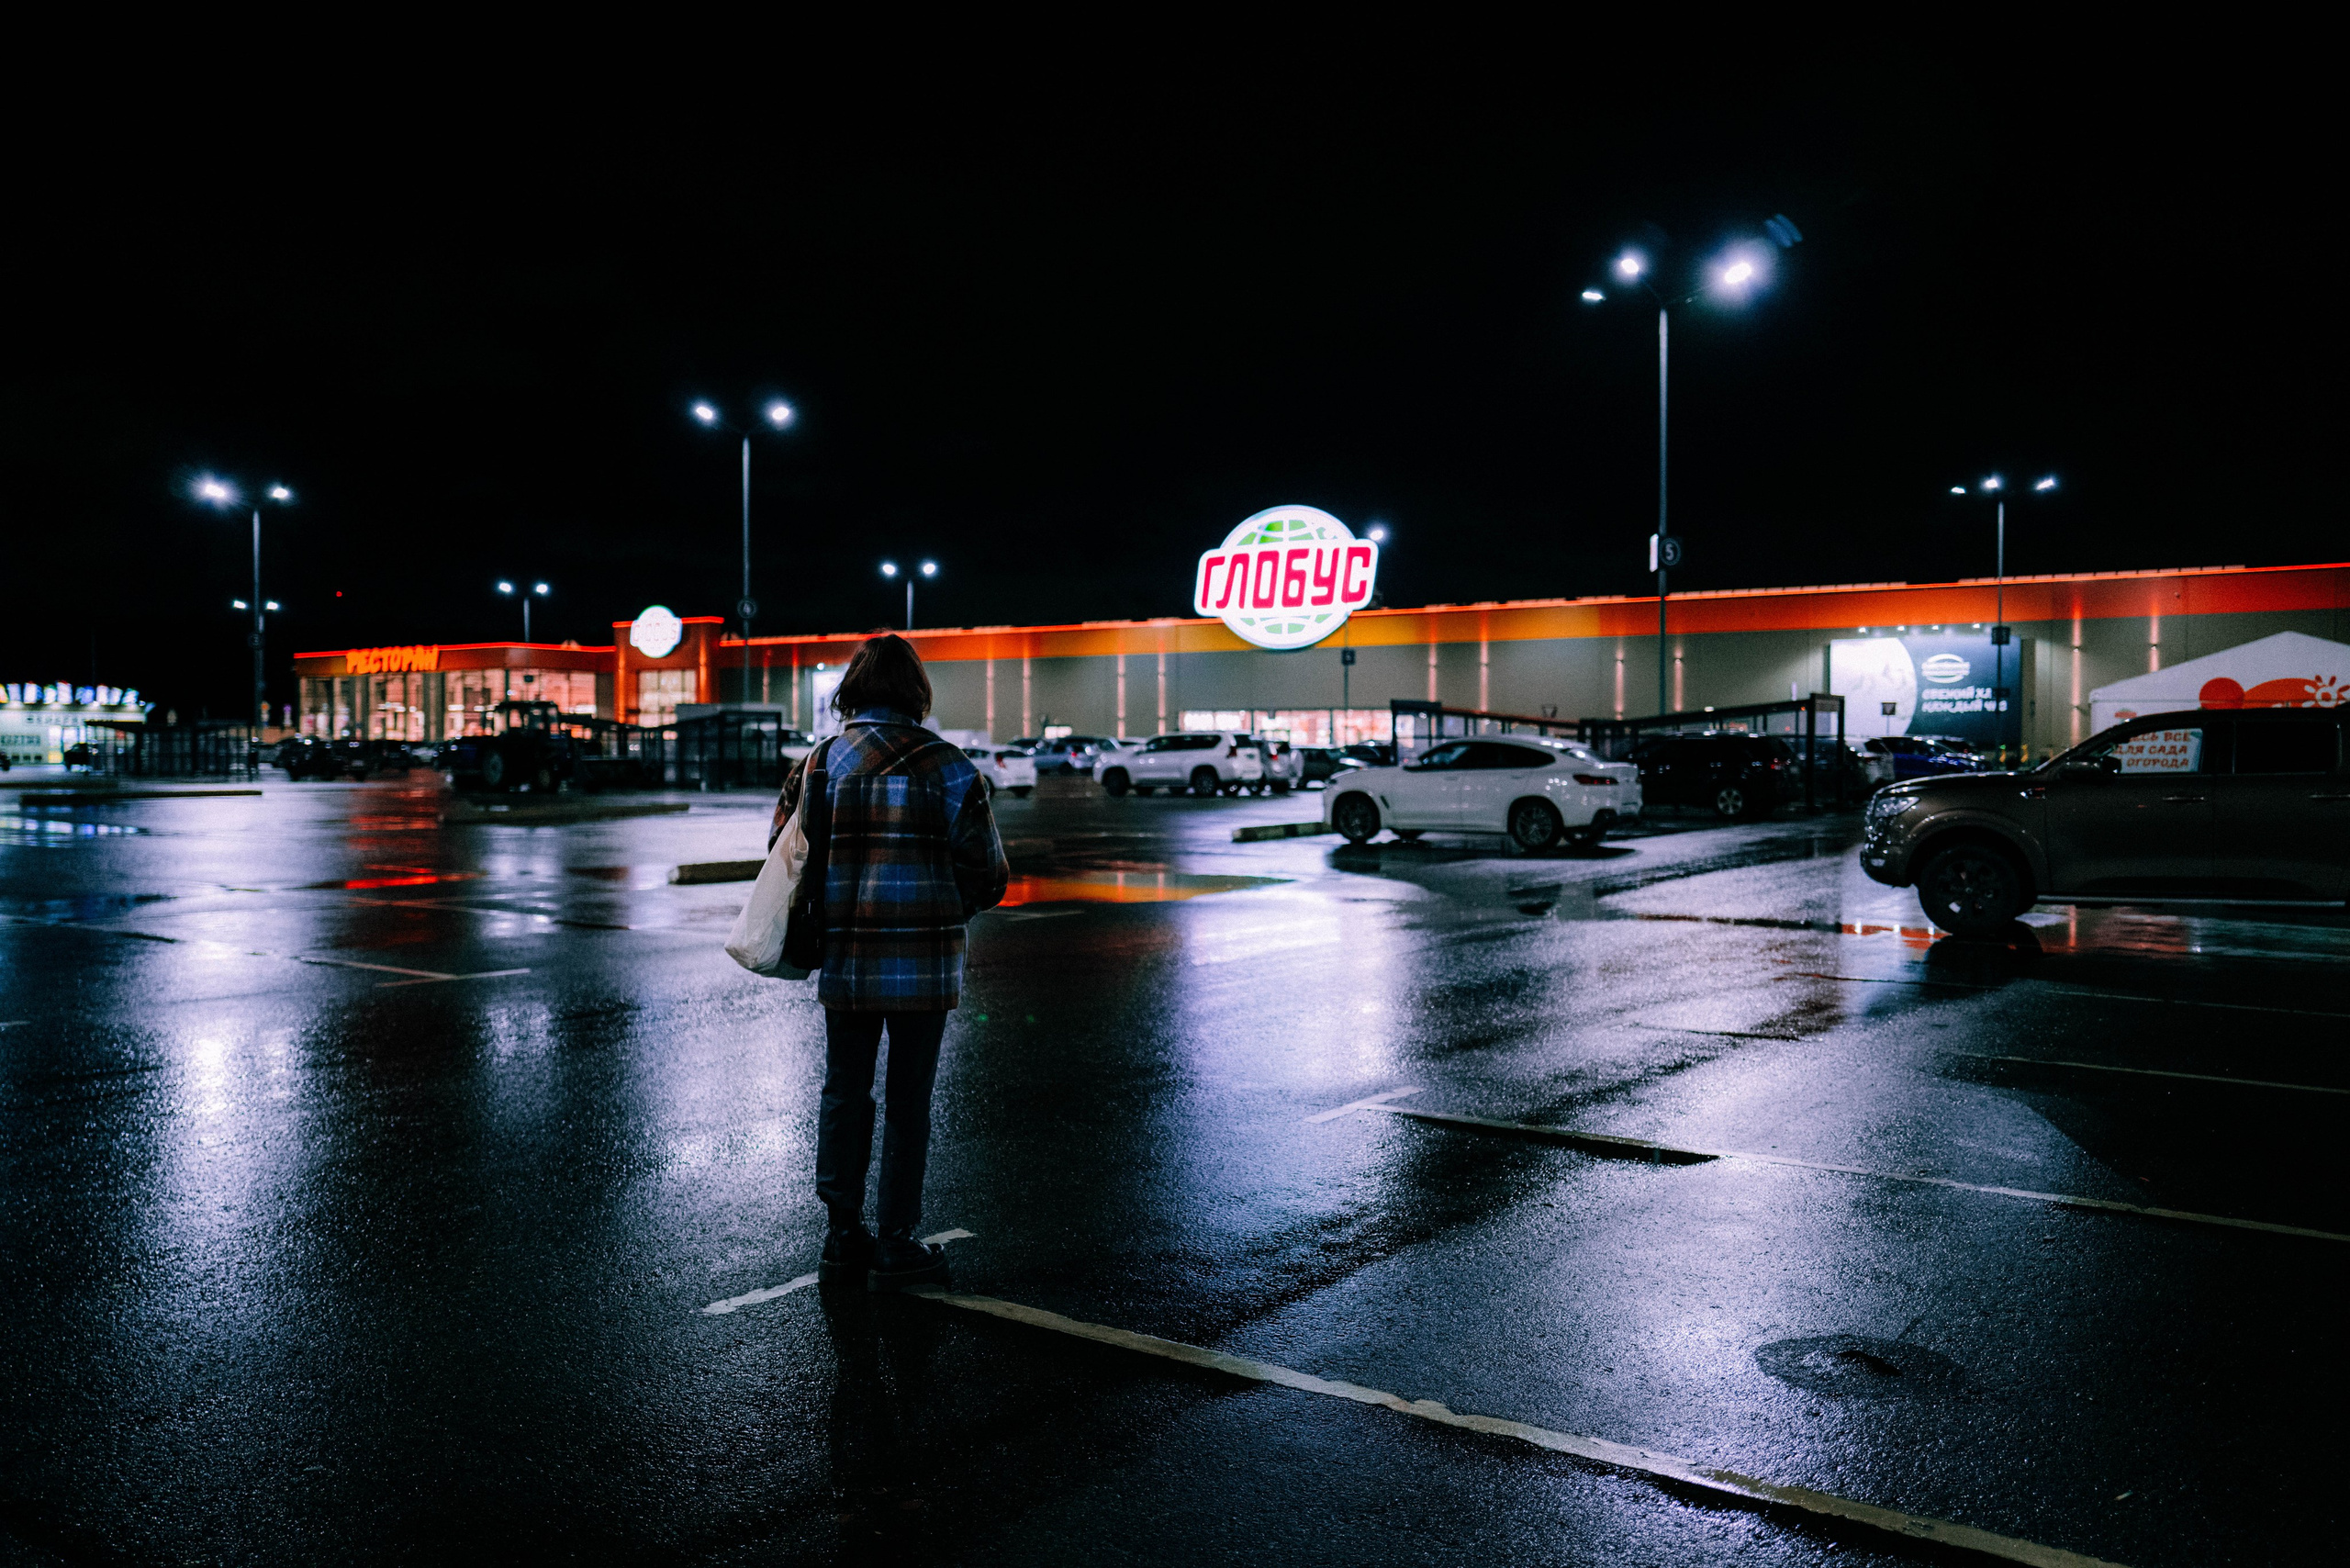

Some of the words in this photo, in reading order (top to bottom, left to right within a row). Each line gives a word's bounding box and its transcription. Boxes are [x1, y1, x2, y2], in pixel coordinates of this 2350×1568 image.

[1665, 543, 1674, 561] 5
[1201, 546, 1371, 610] ГЛОБУС
[346, 645, 439, 675] РЕСТОРАН
[2164, 731, 2190, 742] ВСЕ
[2112, 745, 2144, 755] ДЛЯ
[2148, 745, 2188, 756] САДА
[2127, 758, 2188, 768] ОГОРОДА
